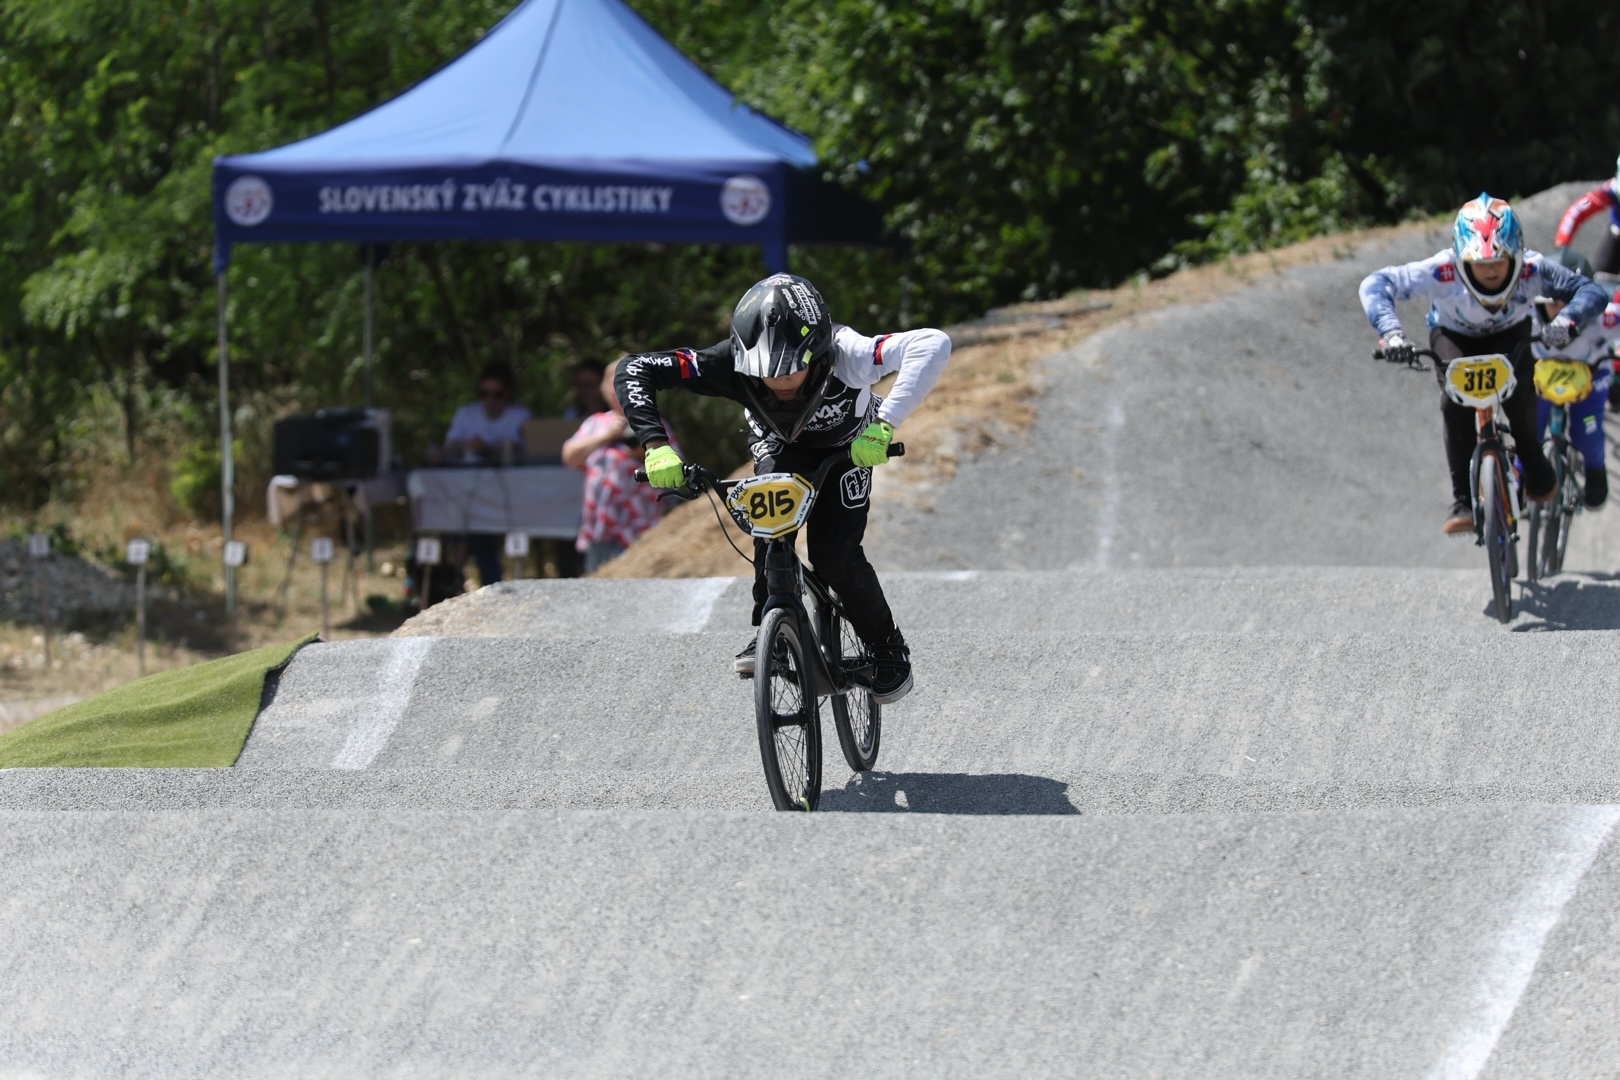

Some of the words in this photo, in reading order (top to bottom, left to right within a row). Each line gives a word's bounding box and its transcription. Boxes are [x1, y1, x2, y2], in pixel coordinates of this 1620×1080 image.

[319, 178, 456, 212] SLOVENSKÝ
[533, 185, 672, 212] CYKLISTIKY
[1464, 367, 1496, 392] 313
[750, 489, 795, 519] 815
